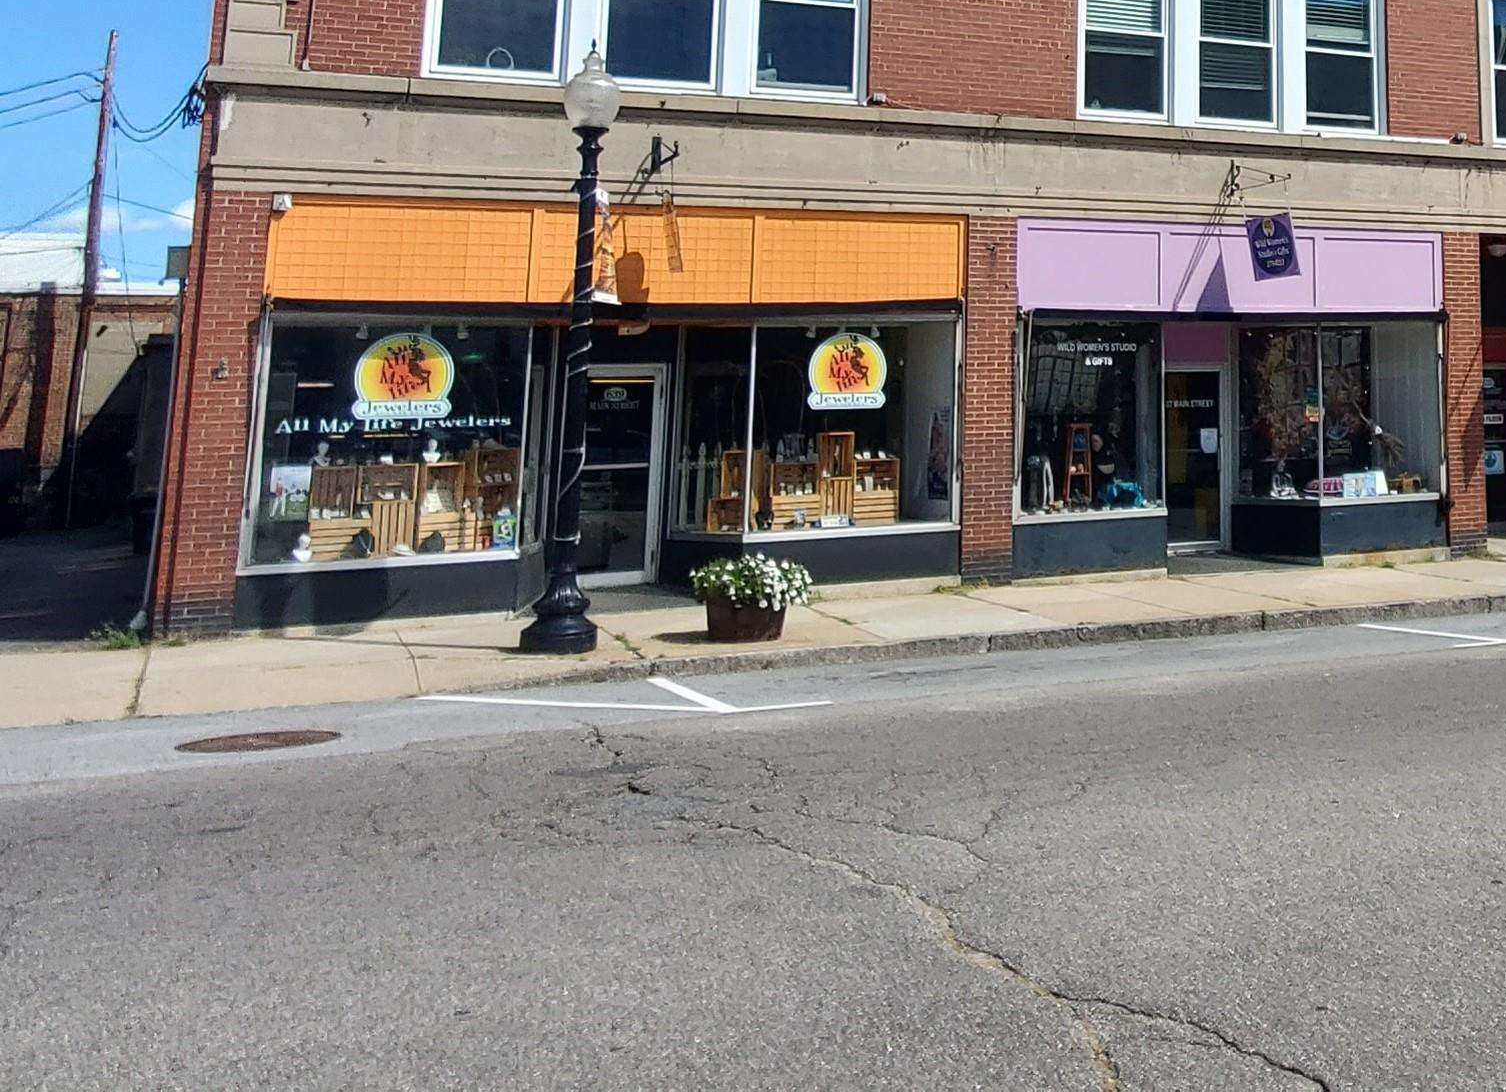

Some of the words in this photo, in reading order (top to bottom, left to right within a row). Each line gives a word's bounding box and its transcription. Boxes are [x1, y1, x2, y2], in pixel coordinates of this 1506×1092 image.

[1057, 342, 1075, 352] WILD
[1077, 342, 1109, 352] WOMEN'S
[1111, 342, 1137, 352] STUDIO
[1092, 357, 1113, 366] GIFTS
[816, 394, 878, 405] Jewelers
[362, 400, 442, 414] Jewelers
[275, 418, 309, 434] All
[319, 418, 354, 433] My
[410, 414, 511, 431] Jewelers
